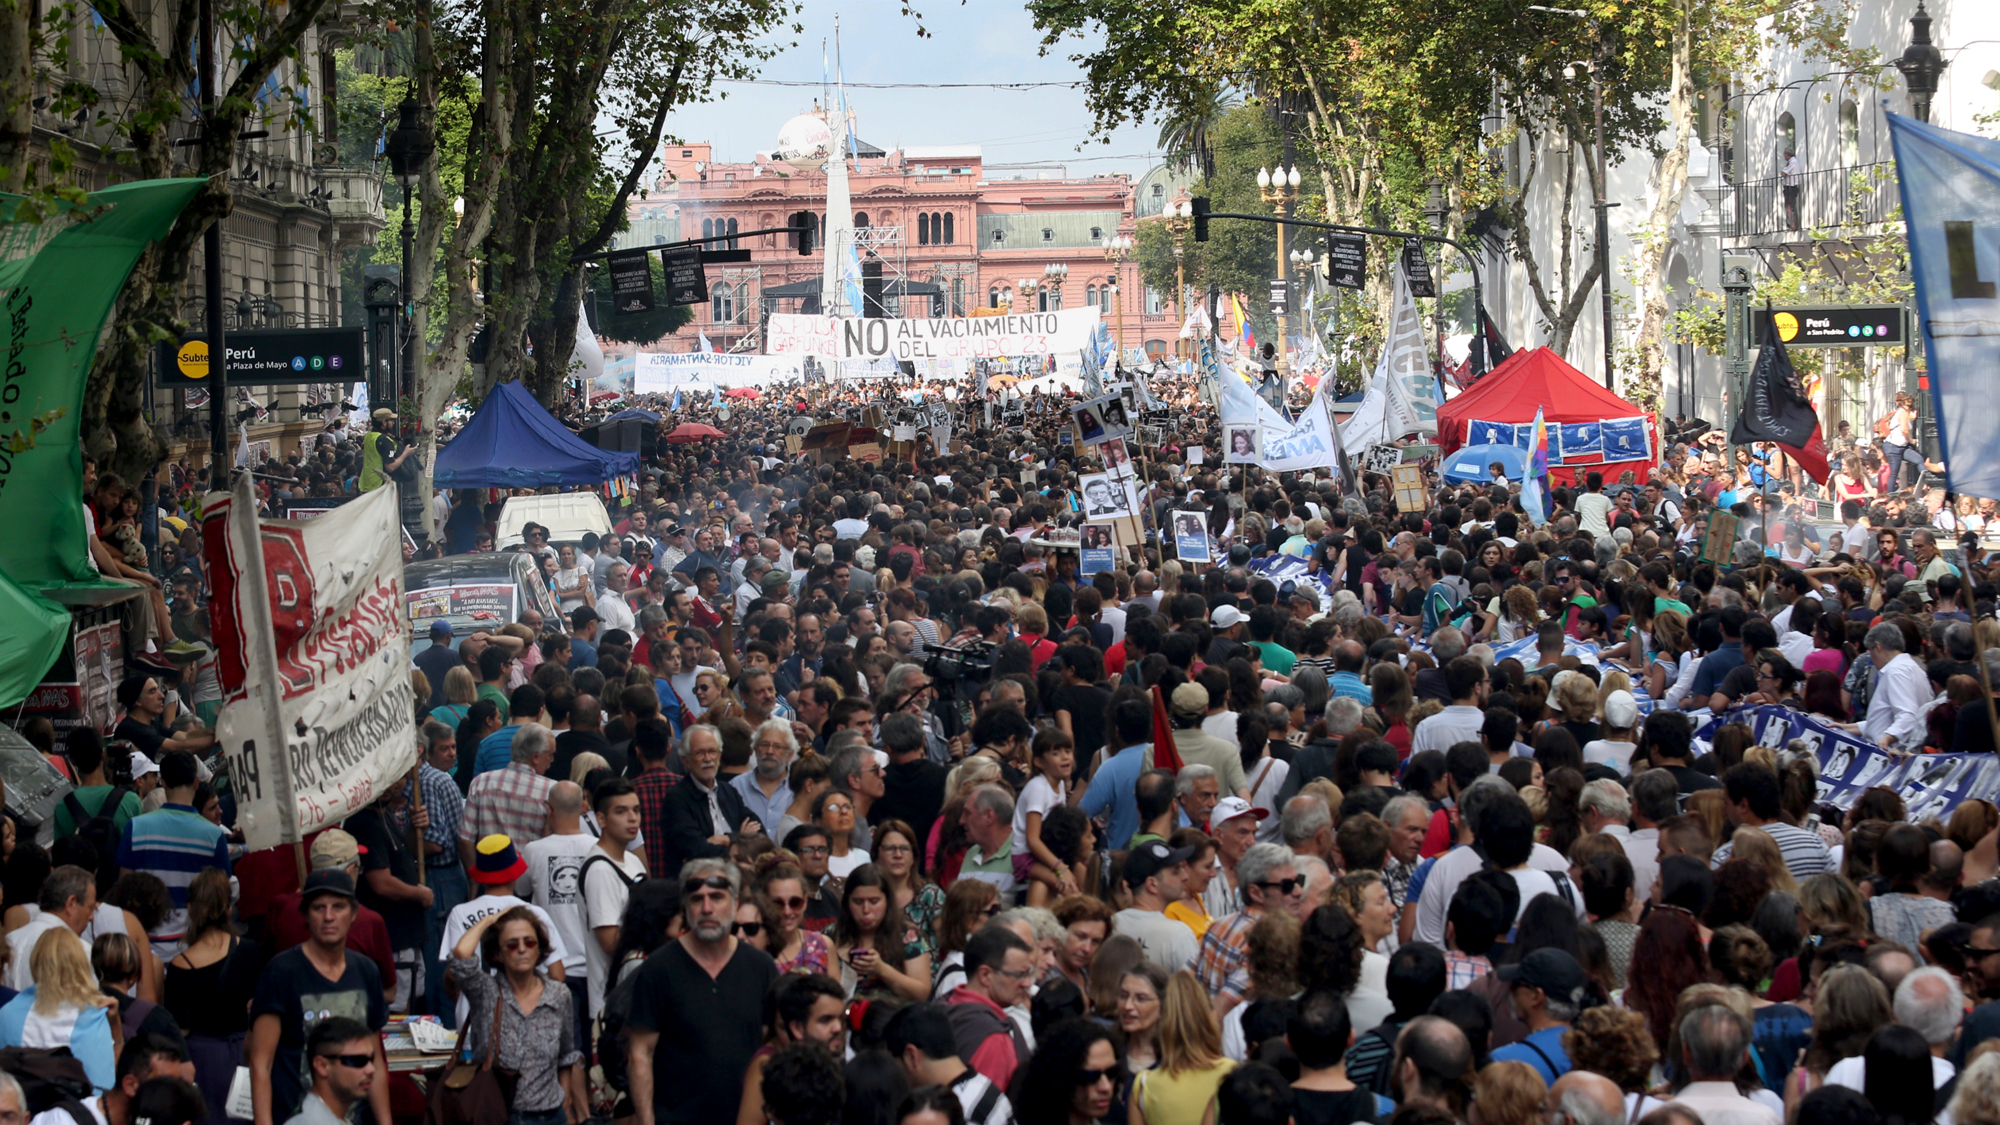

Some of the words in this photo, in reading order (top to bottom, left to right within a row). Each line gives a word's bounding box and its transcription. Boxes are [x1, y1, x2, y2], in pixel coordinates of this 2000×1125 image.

[897, 319, 923, 338] AL
[928, 313, 1058, 338] VACIAMIENTO
[1806, 318, 1830, 328] Perú
[844, 319, 889, 358] NO
[899, 341, 937, 358] DEL
[945, 336, 1011, 357] GRUPO
[1022, 335, 1048, 354] 23
[225, 347, 256, 359] Perú
[266, 361, 288, 370] Mayo
[462, 907, 501, 930] ARGE
